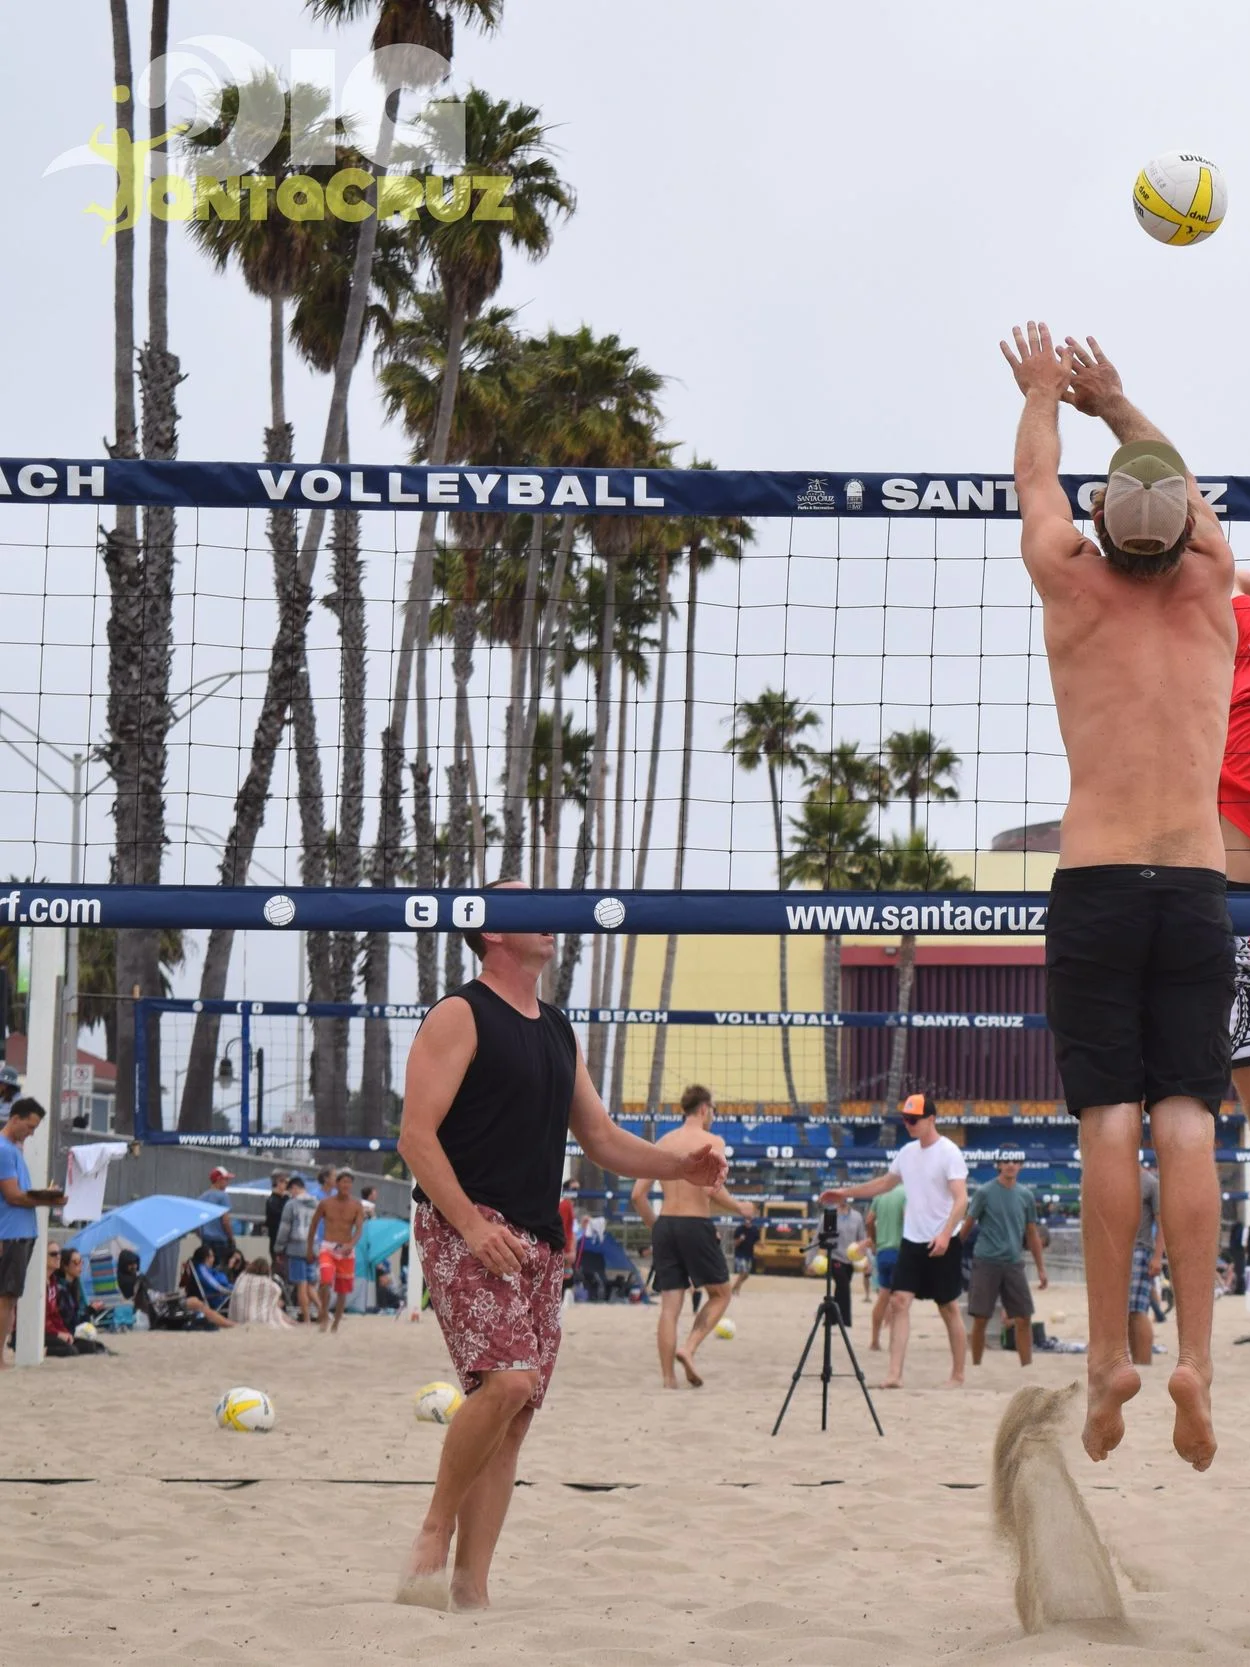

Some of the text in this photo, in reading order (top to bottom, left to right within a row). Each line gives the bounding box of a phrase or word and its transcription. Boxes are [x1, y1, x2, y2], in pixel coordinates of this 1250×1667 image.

[257, 469, 665, 508] VOLLEYBALL
[881, 479, 1017, 512] SANT
[1077, 481, 1228, 515] CZ
[786, 901, 1049, 931] www.santacruz
[384, 1005, 430, 1018] SANT
[598, 1010, 669, 1023] BEACH
[714, 1012, 845, 1026] VOLLEYBALL
[911, 1014, 970, 1027] SANTA
[973, 1015, 1024, 1028] CRUZ
[178, 1134, 320, 1149] www.santauzwharf.com
